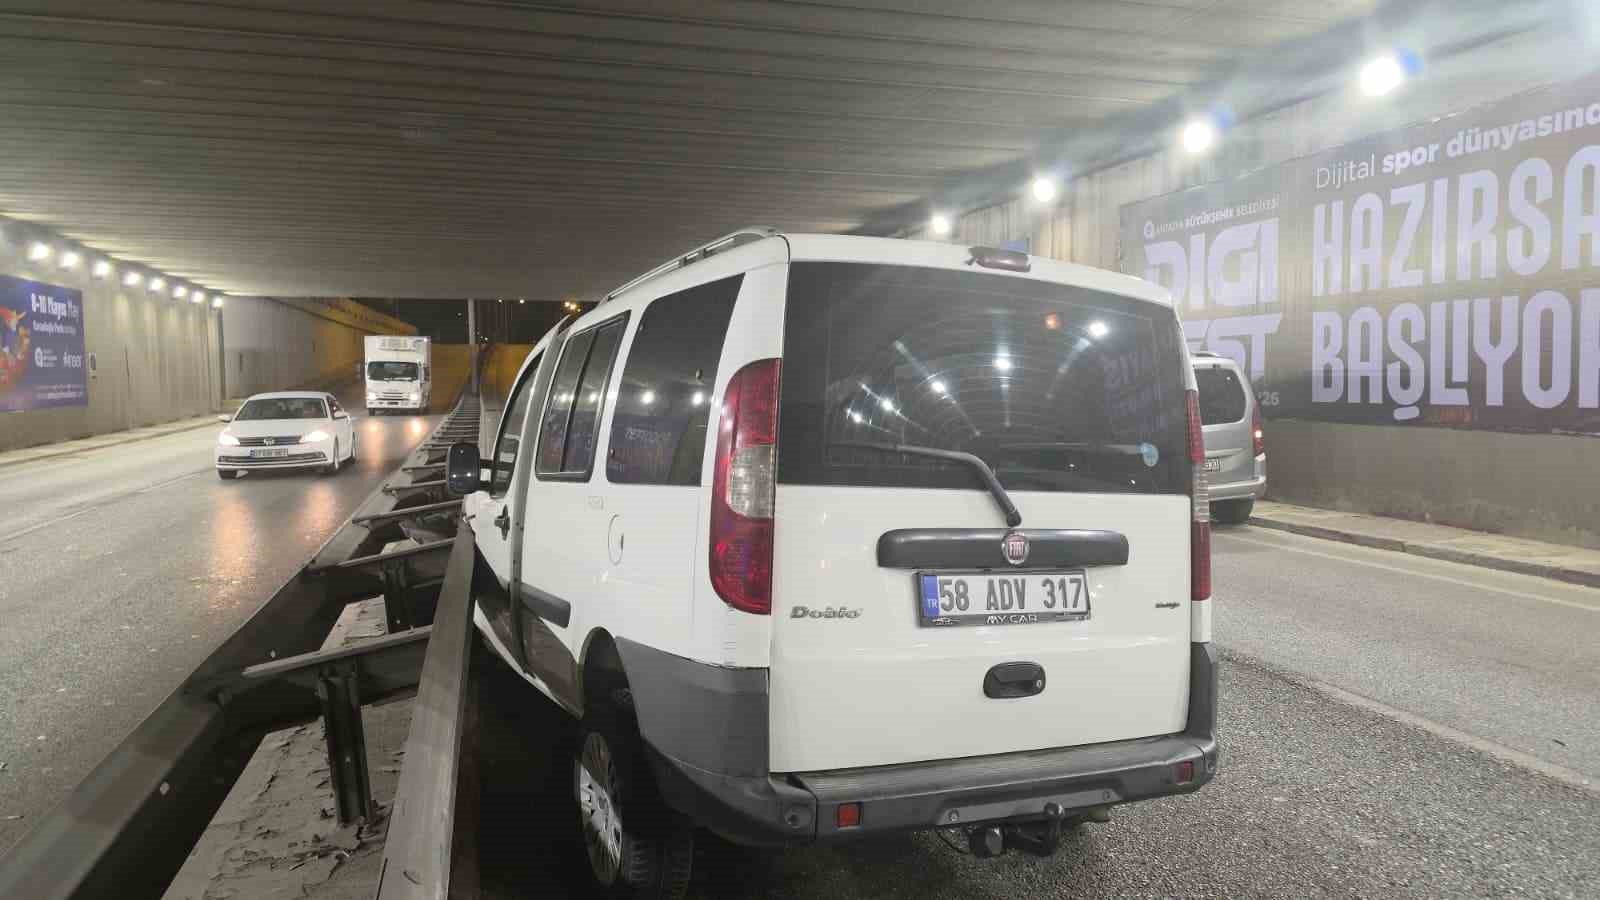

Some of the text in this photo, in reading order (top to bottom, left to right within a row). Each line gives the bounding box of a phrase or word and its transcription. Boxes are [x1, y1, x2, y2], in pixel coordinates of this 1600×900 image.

[1315, 152, 1375, 190] Dijital
[1382, 143, 1439, 176] spor
[1313, 145, 1600, 297] HAZIRSA
[927, 577, 1082, 611] TR 58 ADV 317
